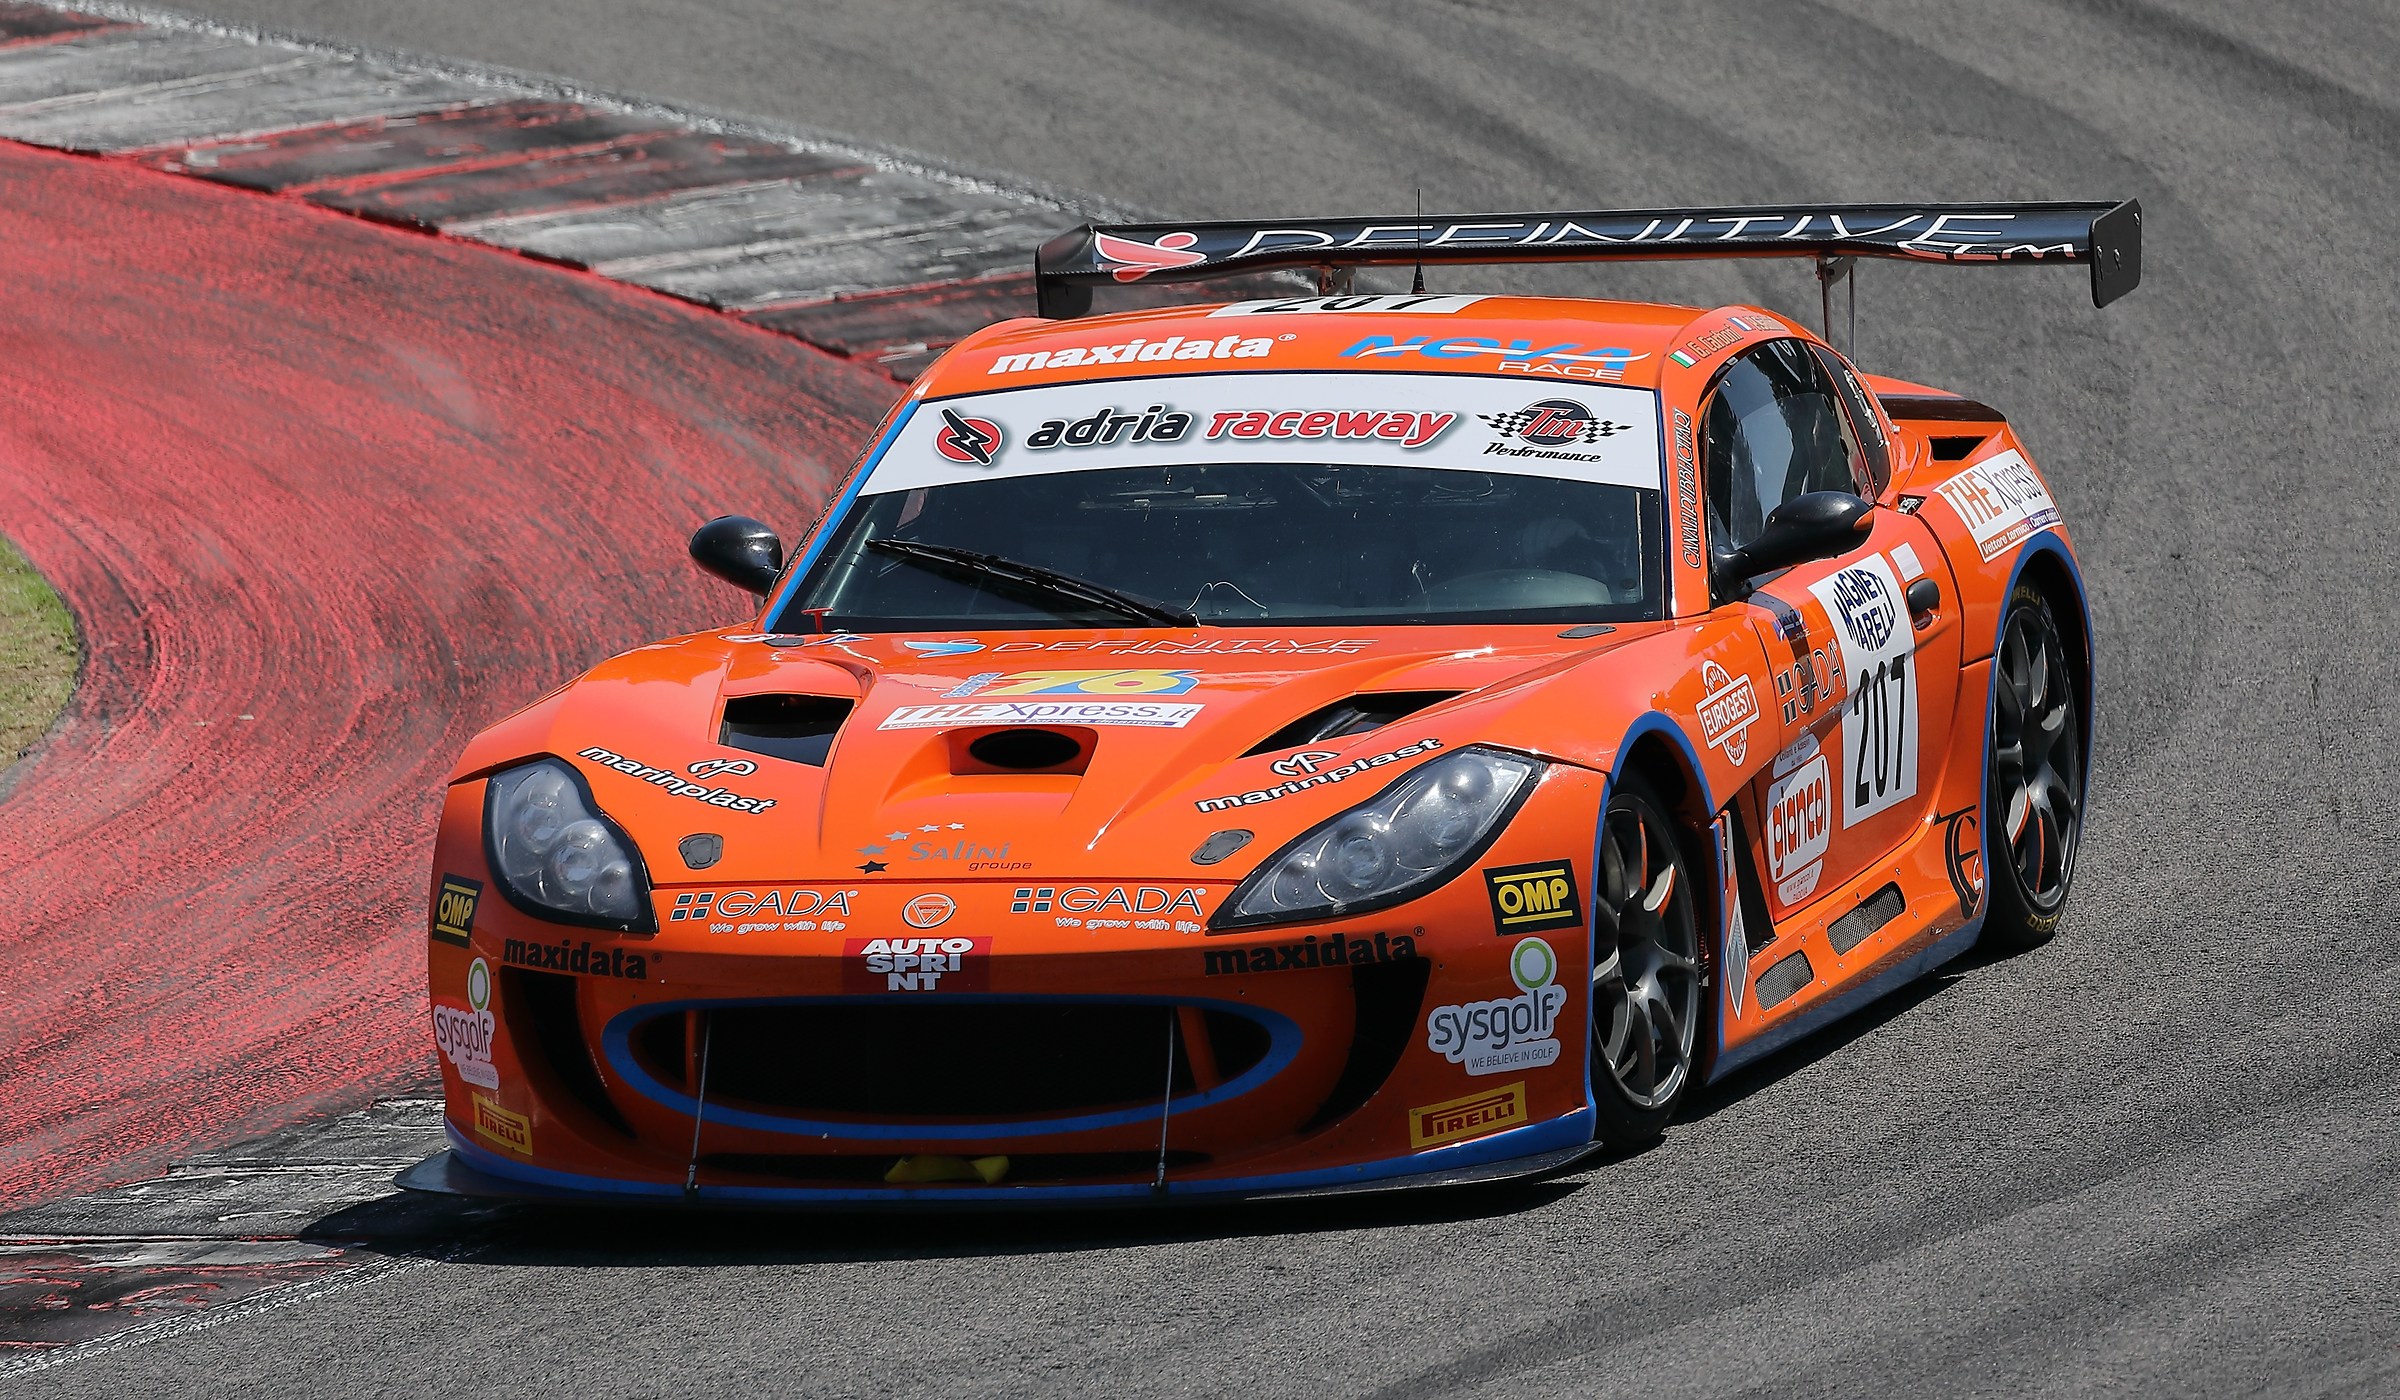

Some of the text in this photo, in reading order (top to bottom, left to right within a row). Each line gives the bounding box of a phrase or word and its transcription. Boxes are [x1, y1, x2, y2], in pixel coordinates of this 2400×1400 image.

[1226, 213, 2016, 259] DEFINITIVE
[1337, 335, 1634, 371] NOVA
[1497, 360, 1625, 381] RACE
[1026, 404, 1456, 448] adria raceway
[1482, 441, 1602, 463] Performance
[991, 639, 1380, 652] DEFINITIVE
[1793, 641, 1845, 714] GADA
[1702, 684, 1753, 737] EUROGEST
[1854, 653, 1906, 808] 207
[577, 746, 778, 814] marinplast
[1195, 737, 1444, 813] marinplast
[1773, 760, 1827, 879] giancol
[968, 861, 1033, 872] groupe
[439, 890, 474, 928] OMP
[716, 890, 851, 918] GADA
[1058, 886, 1204, 917] GADA
[1498, 877, 1570, 916] OMP
[709, 920, 847, 935] We grow with life
[1055, 917, 1201, 935] We grow with life
[860, 937, 974, 955] AUTO
[865, 953, 962, 974] SPRI
[887, 971, 942, 992] NT
[436, 1011, 490, 1061] sysgolf
[1434, 989, 1555, 1056] sysgolf
[1471, 1047, 1554, 1068] WE BELIEVE IN GOLF
[478, 1102, 526, 1146] PIRELLI
[1422, 1091, 1516, 1139] PIRELLI
